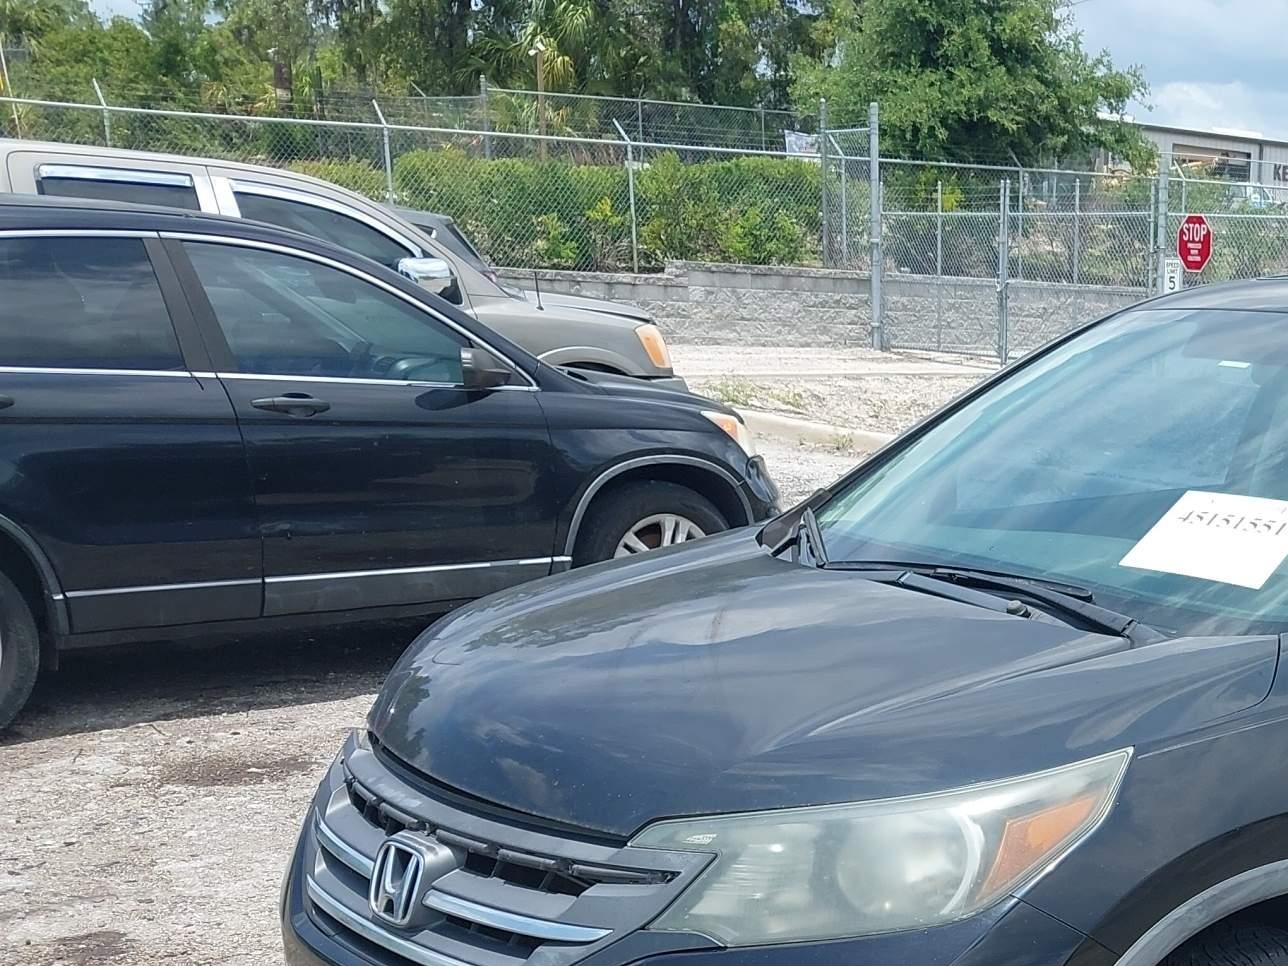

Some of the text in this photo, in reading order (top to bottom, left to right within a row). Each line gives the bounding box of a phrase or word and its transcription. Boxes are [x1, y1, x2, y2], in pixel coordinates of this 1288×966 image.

[1183, 223, 1207, 241] STOP
[1169, 276, 1176, 290] 5
[1178, 510, 1288, 536] 45151551
